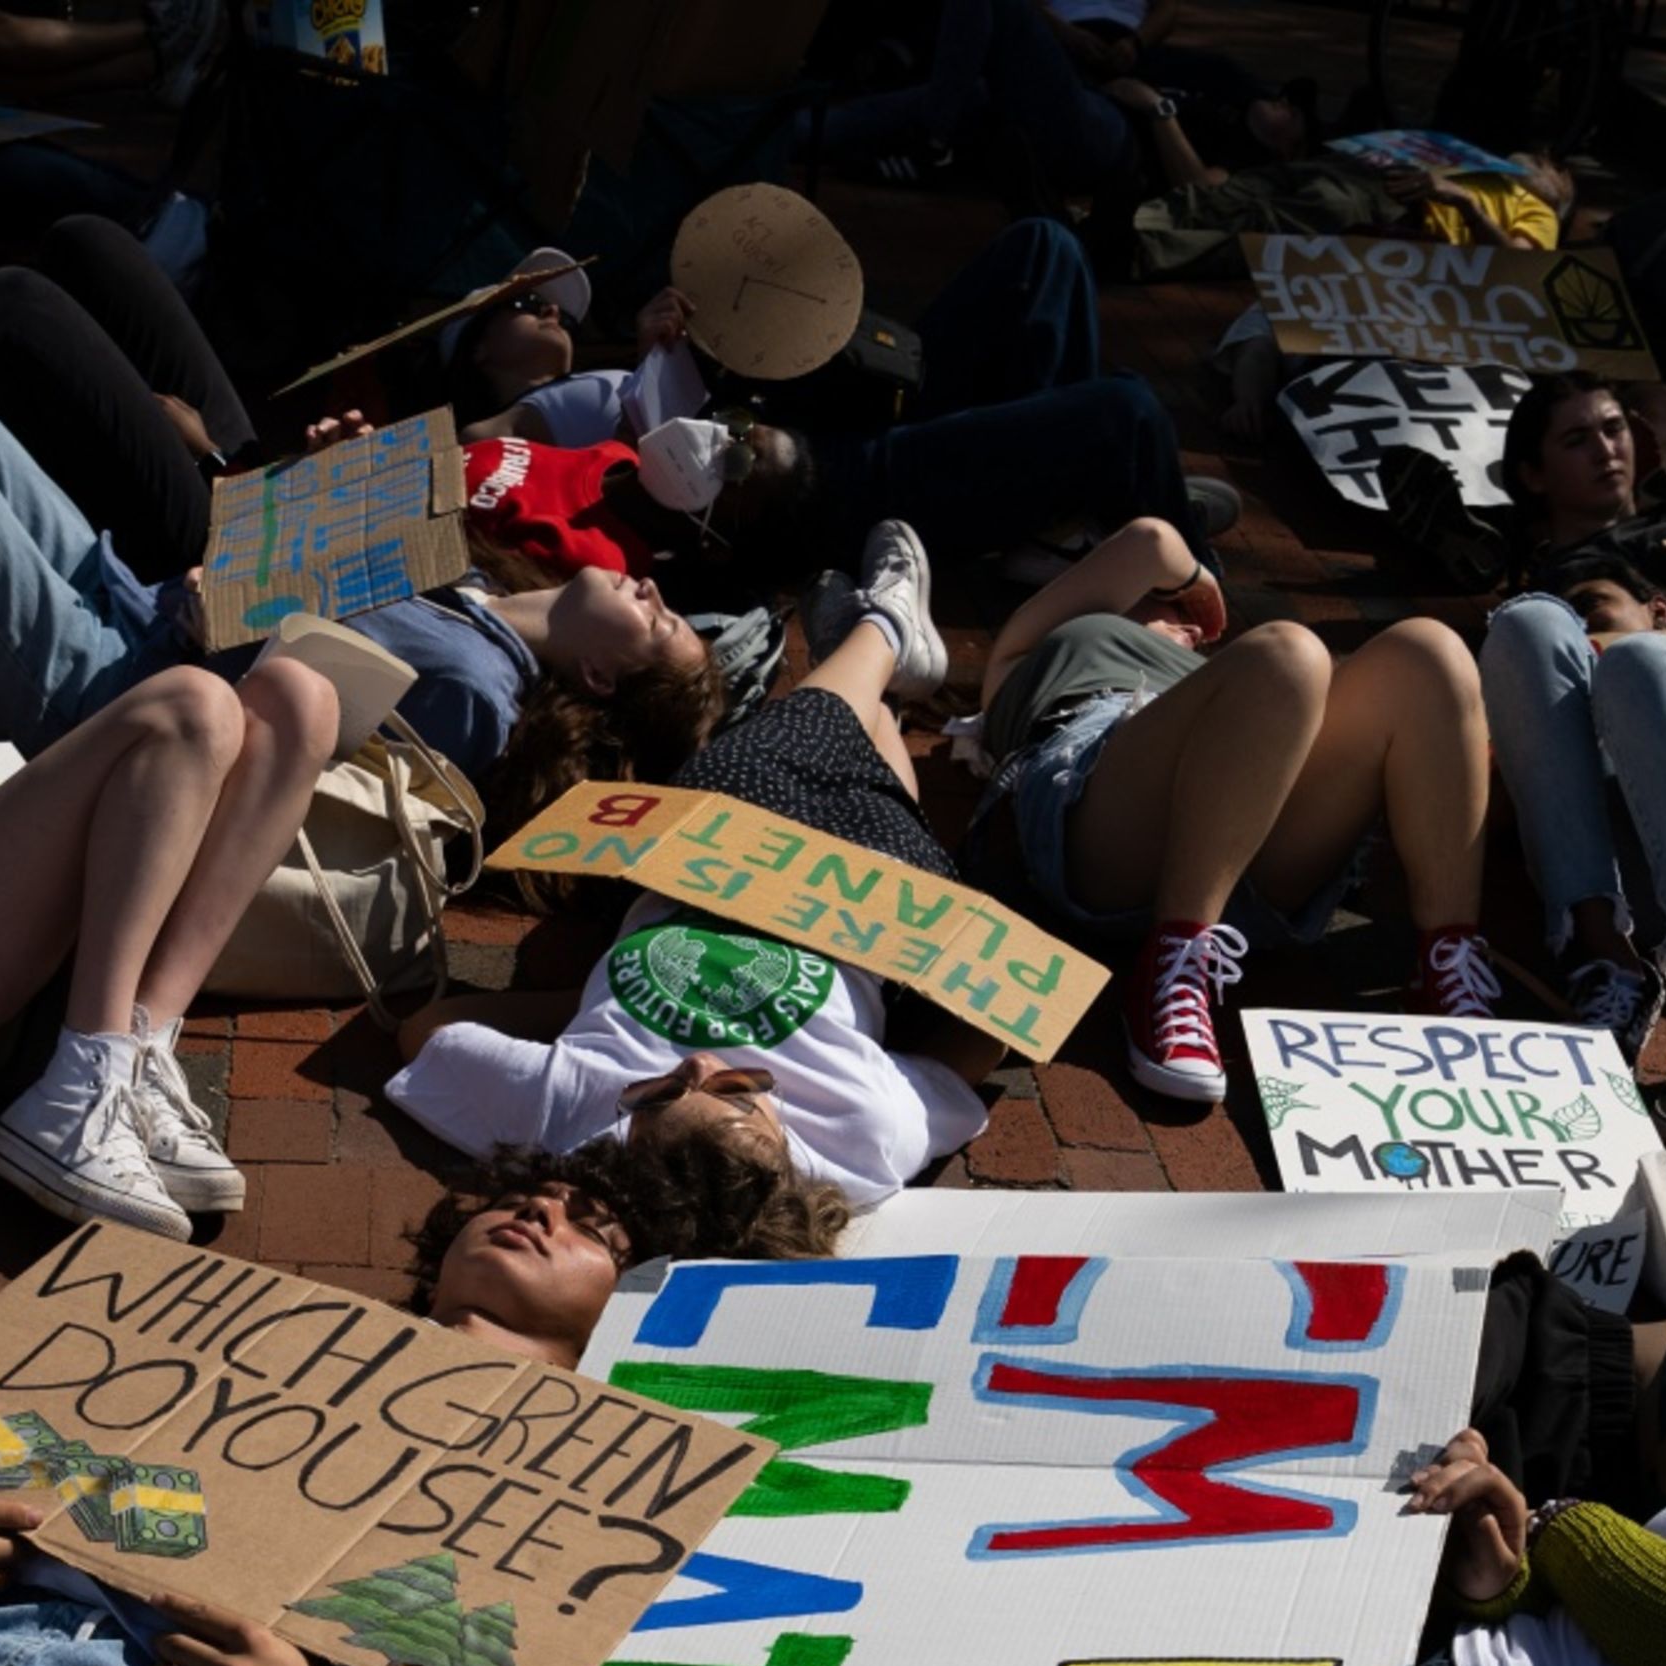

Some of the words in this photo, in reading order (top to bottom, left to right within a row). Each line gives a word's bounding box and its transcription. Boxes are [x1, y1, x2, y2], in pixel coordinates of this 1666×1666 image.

[1262, 234, 1497, 287] NOW
[1250, 270, 1549, 334] JUSTICE
[1309, 321, 1580, 375] CLIMATE
[588, 794, 663, 828] B
[520, 832, 658, 866] NO
[676, 856, 754, 900] IS
[679, 810, 1066, 997] PLANET
[612, 947, 697, 1041] FUTURE
[774, 892, 1048, 1048] THERE
[1268, 1018, 1596, 1086] RESPECT
[1349, 1083, 1570, 1143] YOUR
[1295, 1130, 1617, 1191] MOTHER
[1551, 1233, 1639, 1286] URE
[38, 1224, 417, 1403] WHICH
[380, 1359, 755, 1522] GREEN
[377, 1461, 686, 1618] SEE?
